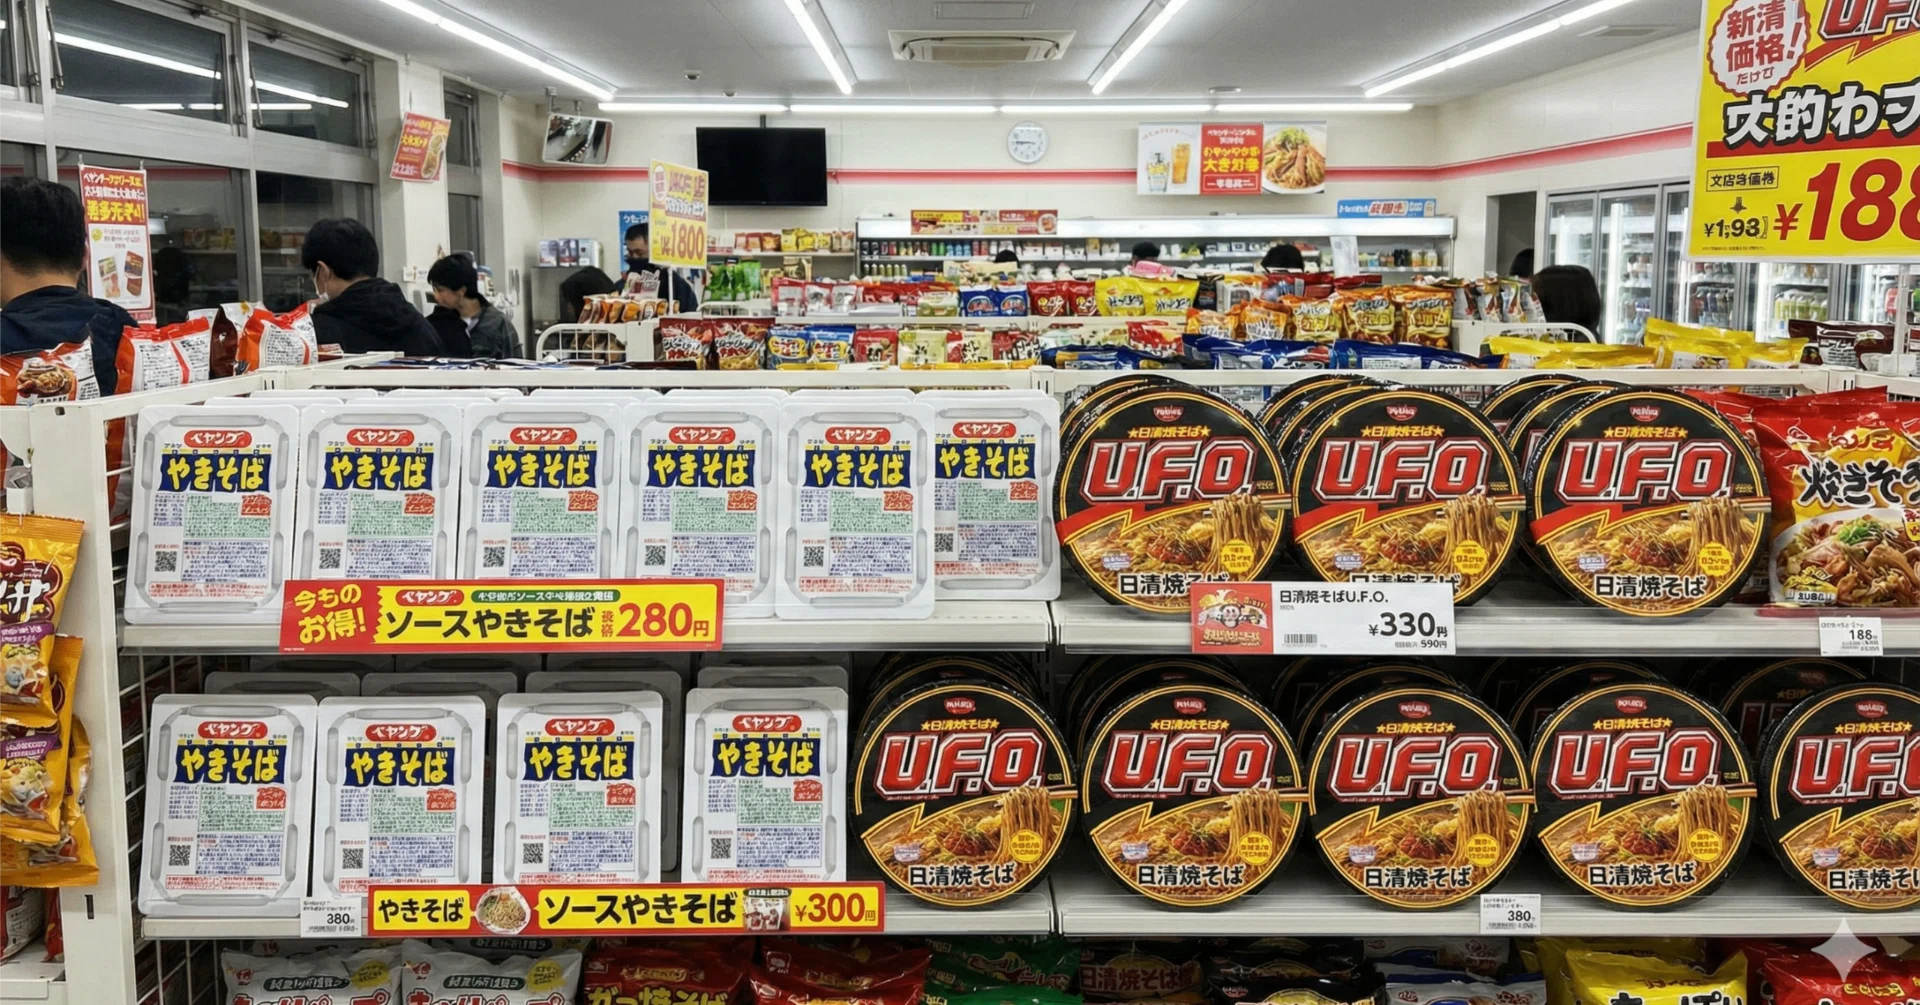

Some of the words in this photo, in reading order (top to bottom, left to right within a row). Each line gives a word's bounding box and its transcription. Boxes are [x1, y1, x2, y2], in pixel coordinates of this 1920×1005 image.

[190, 430, 244, 446] ペヤング
[353, 429, 408, 444] ペヤング
[516, 428, 568, 443] ペヤング
[675, 428, 729, 443] ペヤング
[830, 428, 884, 443] ペヤング
[959, 423, 1009, 436] ペヤング
[168, 456, 264, 490] やきそば
[331, 454, 427, 488] やきそば
[495, 453, 591, 486] やきそば
[654, 453, 748, 486] やきそば
[811, 453, 905, 486] やきそば
[941, 447, 1029, 477] やきそば
[402, 590, 458, 604] ペヤング
[1596, 575, 1706, 597] 日清焼そば
[293, 583, 362, 614] 今もの
[298, 606, 367, 644] お得!
[386, 607, 595, 638] ソースやきそば
[616, 602, 710, 637] 280円
[205, 723, 258, 737] ペヤング
[373, 725, 427, 739] ペヤング
[551, 719, 606, 734] ペヤング
[739, 715, 793, 730] ペヤング
[182, 748, 279, 783] やきそば
[351, 750, 448, 785] やきそば
[529, 744, 628, 780] やきそば
[718, 740, 815, 776] やきそば
[910, 864, 1015, 886] 日清焼そば
[1138, 864, 1244, 886] 日清焼そば
[1366, 866, 1472, 888] 日清焼そば
[1589, 863, 1695, 885] 日清焼そば
[378, 896, 464, 923] やきそば
[545, 890, 736, 924] ソースやきそば
